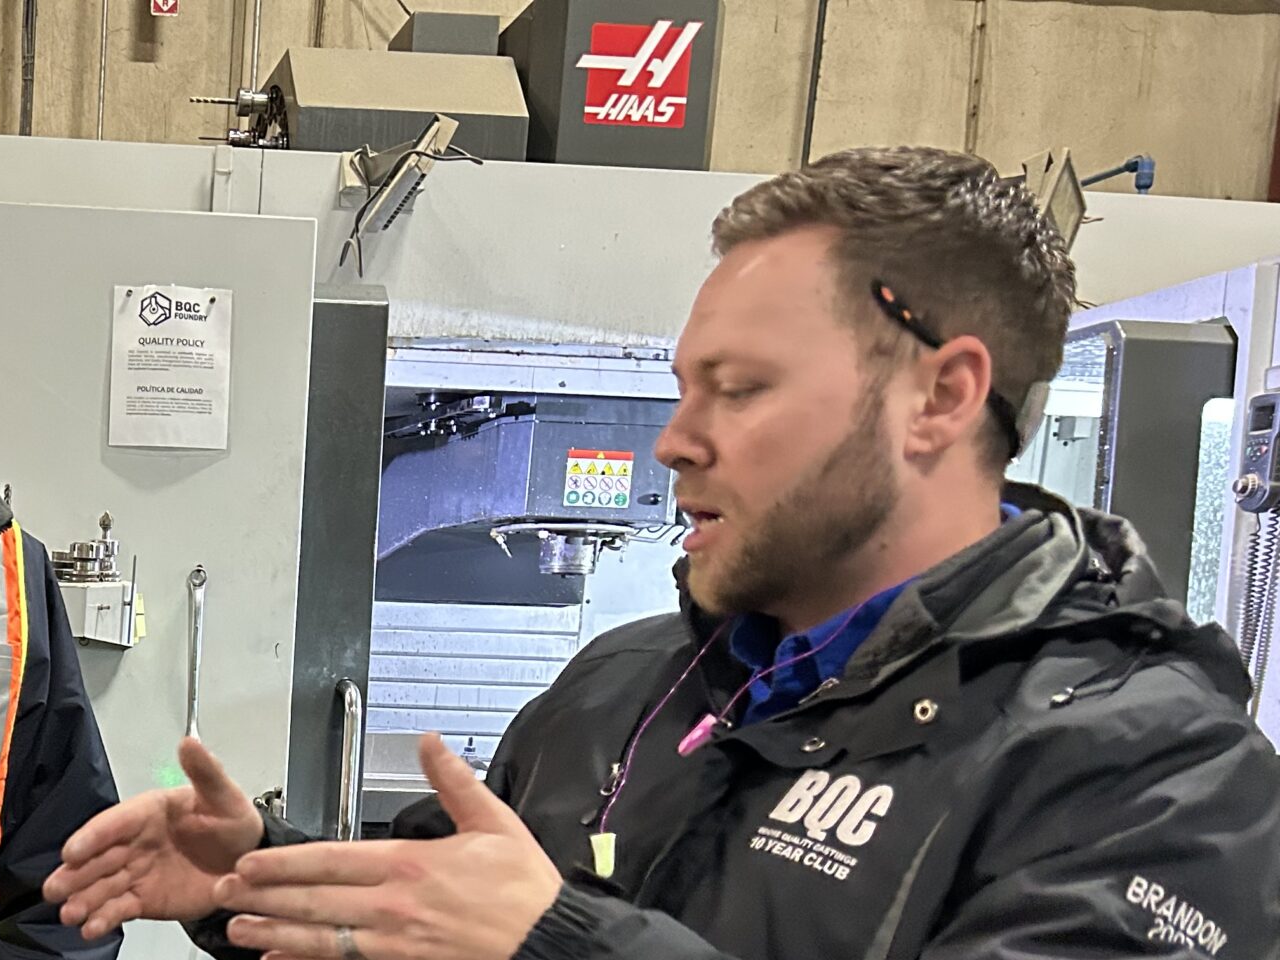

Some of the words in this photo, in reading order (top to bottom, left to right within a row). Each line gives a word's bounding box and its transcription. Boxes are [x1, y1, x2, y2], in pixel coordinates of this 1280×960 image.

[584, 93, 688, 123] HAAS
[174, 312, 208, 322] FOUNDRY
[175, 301, 201, 313] BQC
[138, 336, 175, 348] QUALITY
[176, 338, 206, 348] POLICY
[136, 385, 166, 394] POLÍTICA
[166, 386, 175, 394] DE
[176, 386, 204, 395] CALIDAD
[768, 769, 894, 846] BQC
[750, 836, 765, 851] 10
[764, 839, 804, 863] YEAR
[803, 852, 851, 881] CLUB
[780, 832, 815, 850] QUALITY
[812, 843, 859, 867] CASTINGS
[1126, 876, 1228, 956] BRANDON
